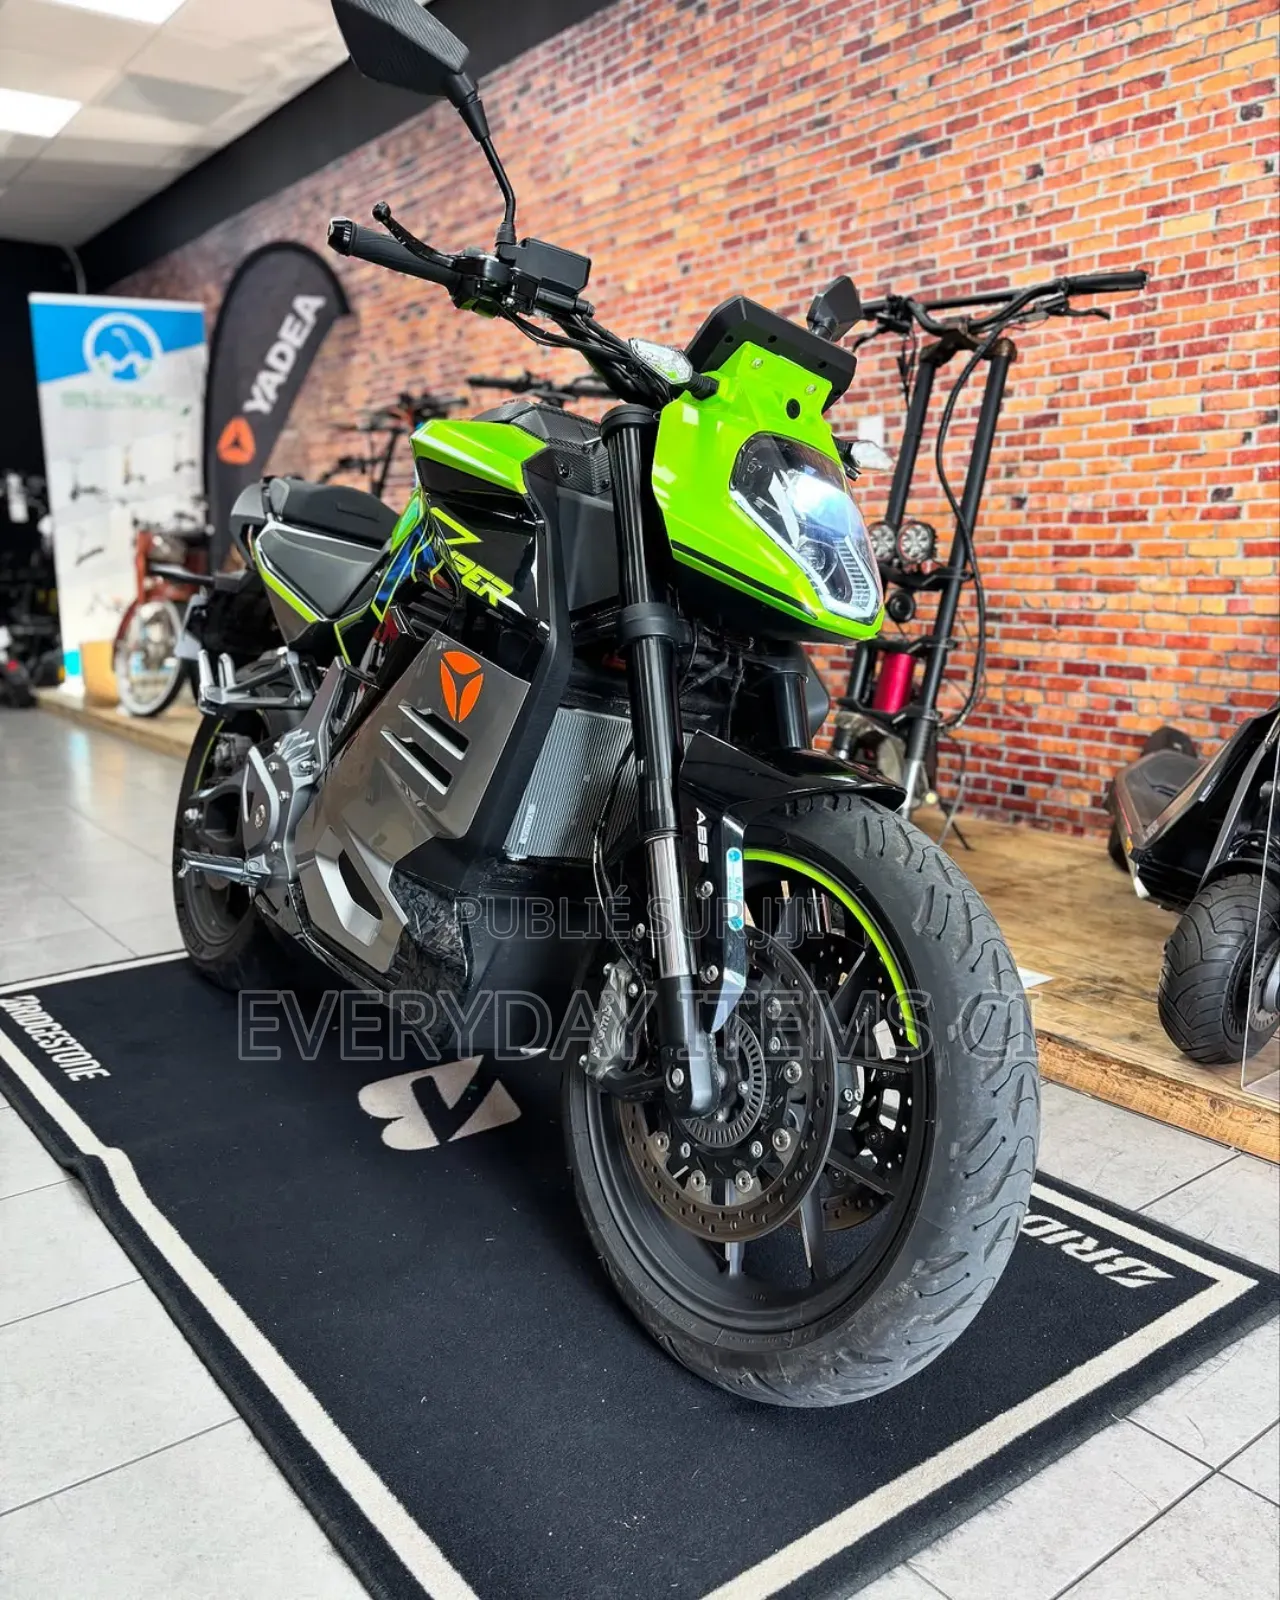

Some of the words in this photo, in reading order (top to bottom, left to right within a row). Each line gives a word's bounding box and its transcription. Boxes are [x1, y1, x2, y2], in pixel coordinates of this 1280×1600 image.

[243, 295, 326, 414] YADEA
[696, 807, 709, 863] ABS
[0, 995, 111, 1081] BRIDGESTONE
